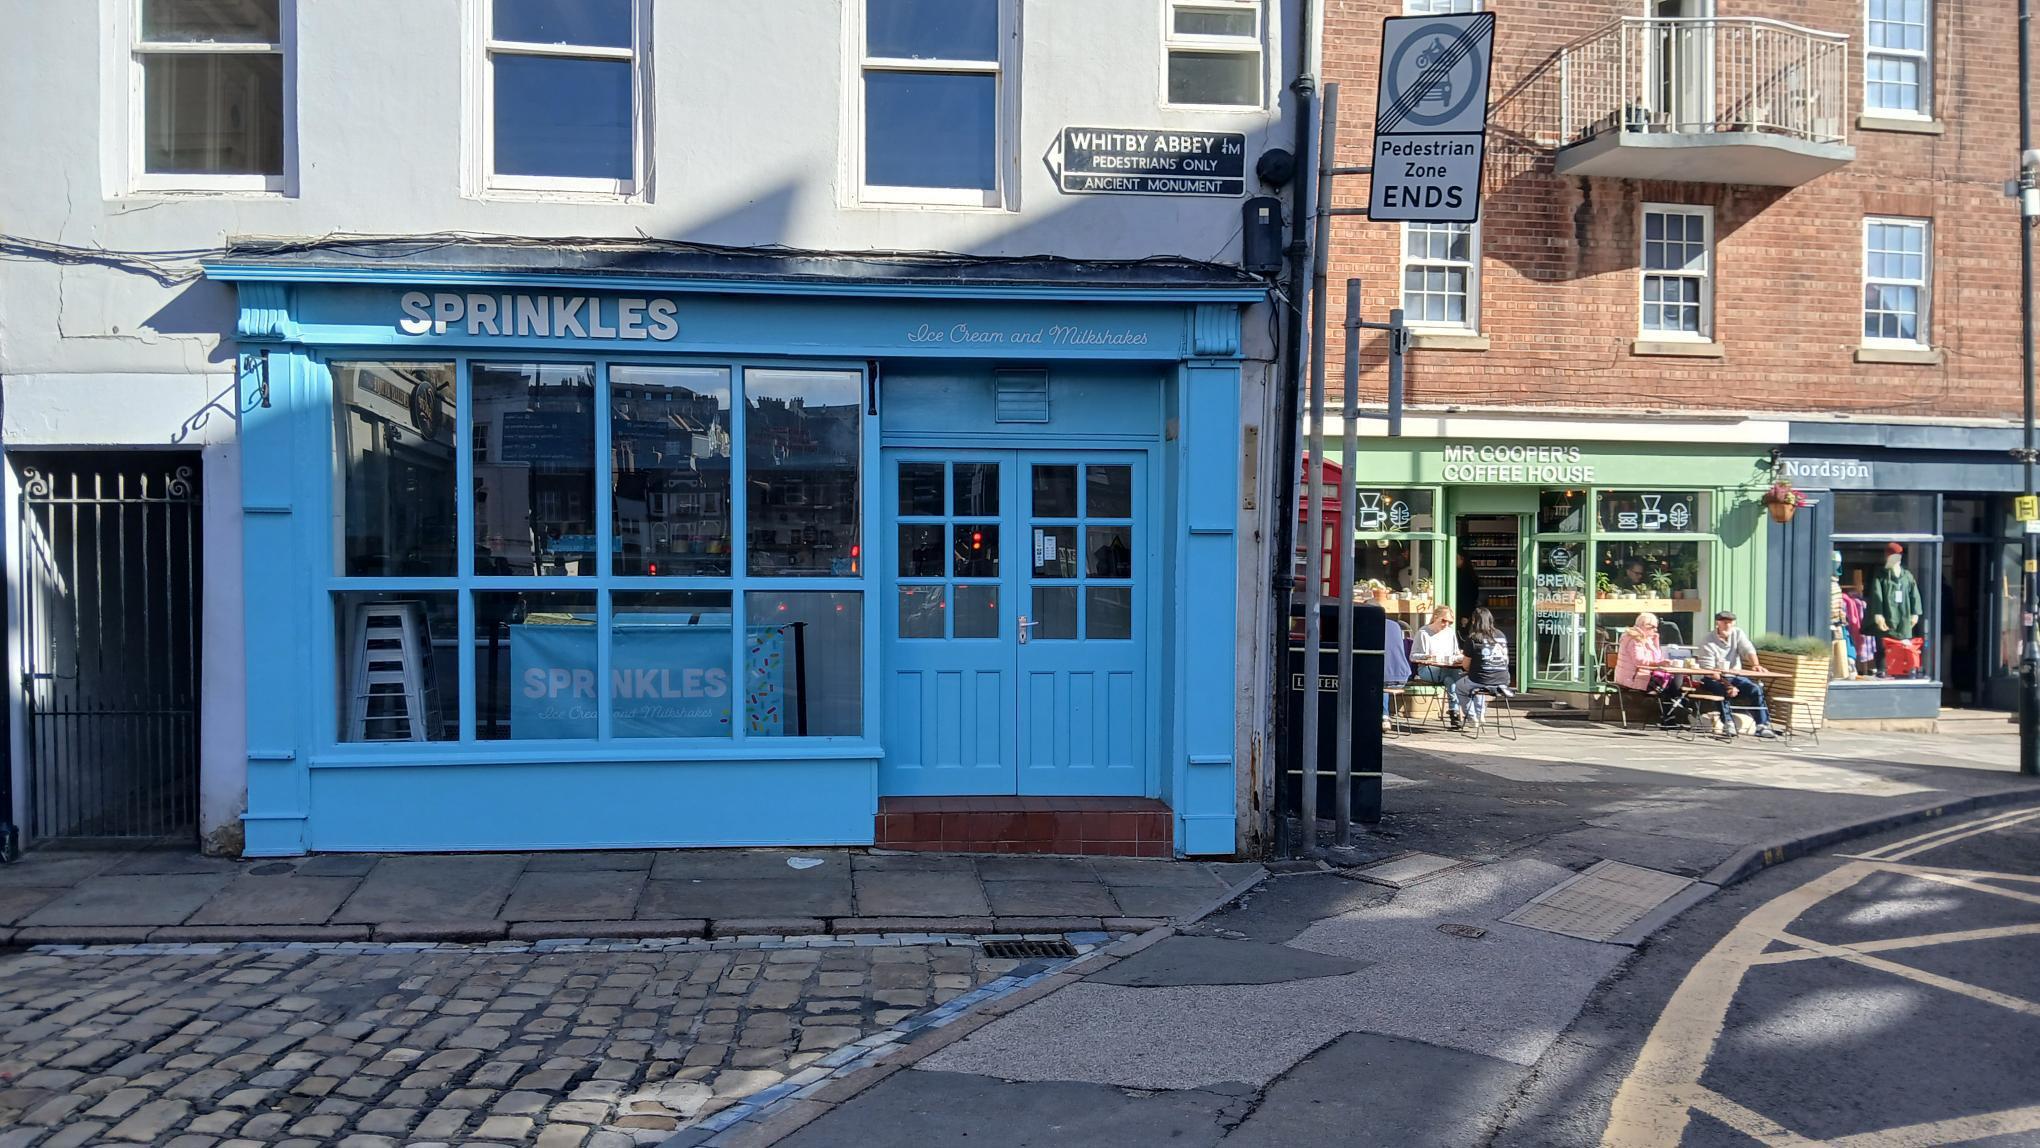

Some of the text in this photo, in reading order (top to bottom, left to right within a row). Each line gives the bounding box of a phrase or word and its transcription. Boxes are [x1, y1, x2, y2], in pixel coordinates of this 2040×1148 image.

[1071, 133, 1149, 152] WHITBY
[1154, 135, 1215, 154] ABBEY
[1381, 141, 1474, 156] Pedestrian
[1092, 155, 1218, 171] PEDESTRIANS ONLY
[1404, 162, 1447, 178] Zone
[1084, 177, 1223, 193] ANCIENT MONUMENT
[1383, 185, 1464, 209] ENDS
[400, 291, 679, 341] SPRINKLES
[907, 323, 1148, 345] Ice Cream and Milkshakes
[1443, 445, 1581, 463] MR COOPER'S
[1443, 464, 1596, 483] COFFEE HOUSE
[523, 667, 728, 698] SPRNKLES
[1296, 677, 1339, 689] LTER
[568, 704, 600, 719] Crea
[639, 704, 713, 719] Milkshakes
